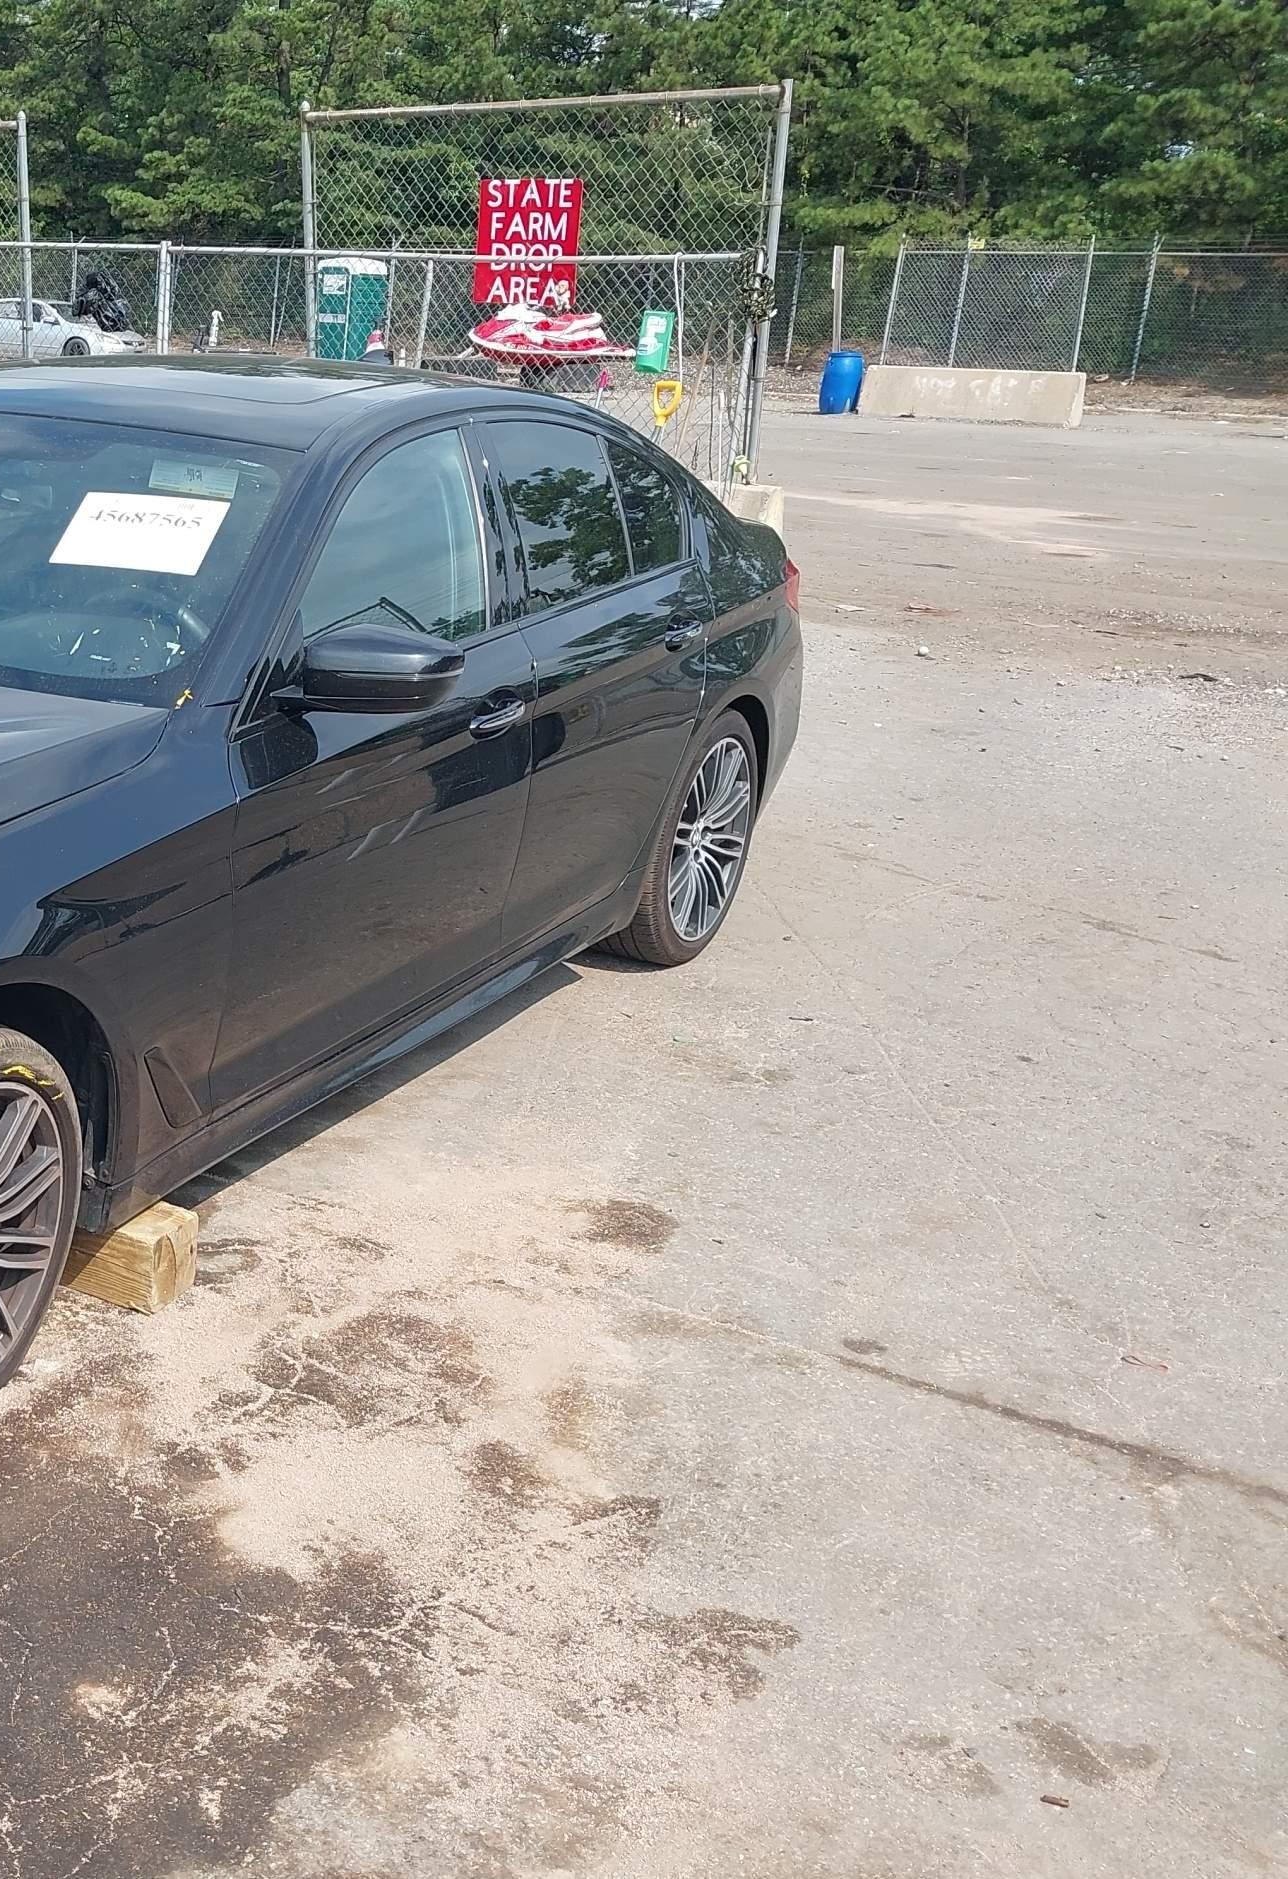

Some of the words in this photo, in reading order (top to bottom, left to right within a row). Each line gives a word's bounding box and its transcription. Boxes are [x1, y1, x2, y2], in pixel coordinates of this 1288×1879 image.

[487, 179, 573, 208] STATE
[490, 211, 568, 241] FARM
[490, 243, 563, 272] DROP
[486, 276, 560, 308] AREA
[90, 510, 204, 529] 45687565
